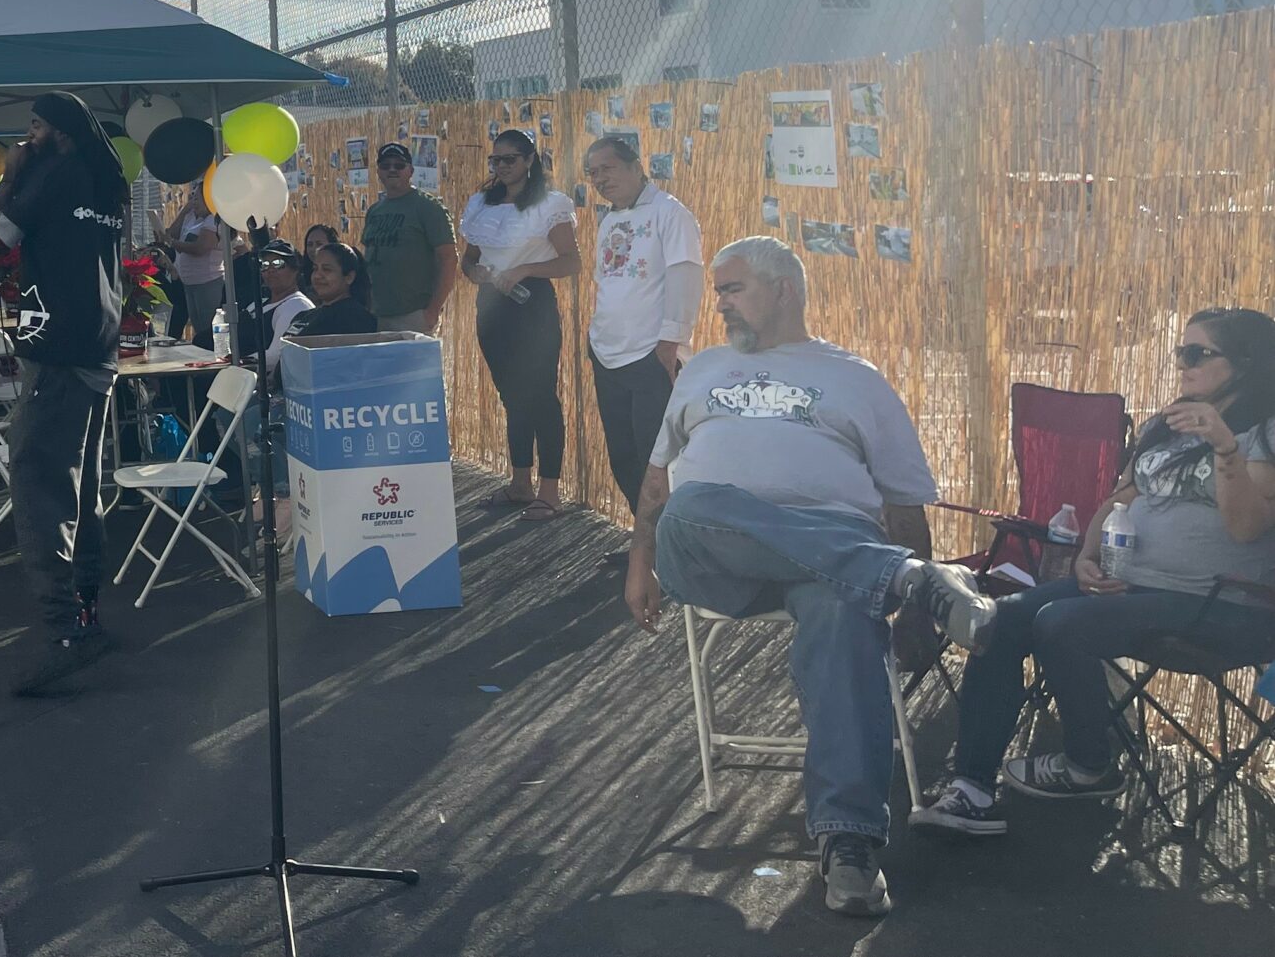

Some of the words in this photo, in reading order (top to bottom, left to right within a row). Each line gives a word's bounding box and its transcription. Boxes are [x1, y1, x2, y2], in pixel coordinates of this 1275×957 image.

[285, 397, 312, 429] RECYCLE
[324, 402, 439, 430] RECYCLE
[361, 510, 415, 521] REPUBLIC
[373, 519, 404, 527] SERVICES
